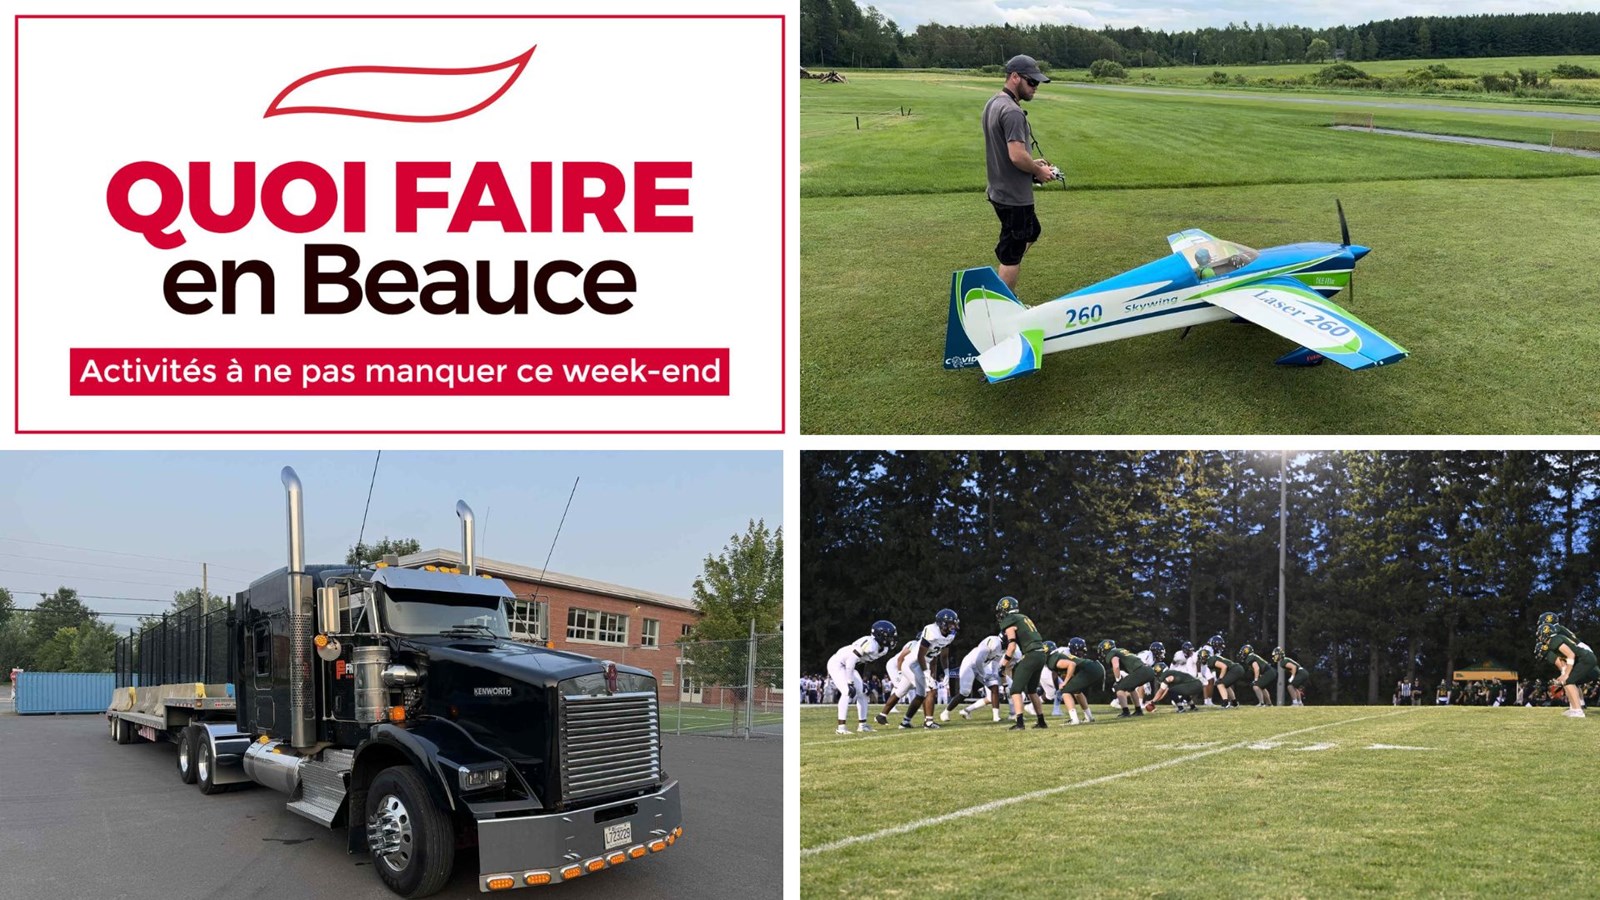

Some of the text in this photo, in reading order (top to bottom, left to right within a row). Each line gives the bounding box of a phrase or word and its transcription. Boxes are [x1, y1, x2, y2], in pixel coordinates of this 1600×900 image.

[1124, 296, 1178, 313] Skywing
[1253, 290, 1350, 337] Laser 260
[1065, 304, 1102, 328] 260
[473, 687, 512, 697] KENWORTH
